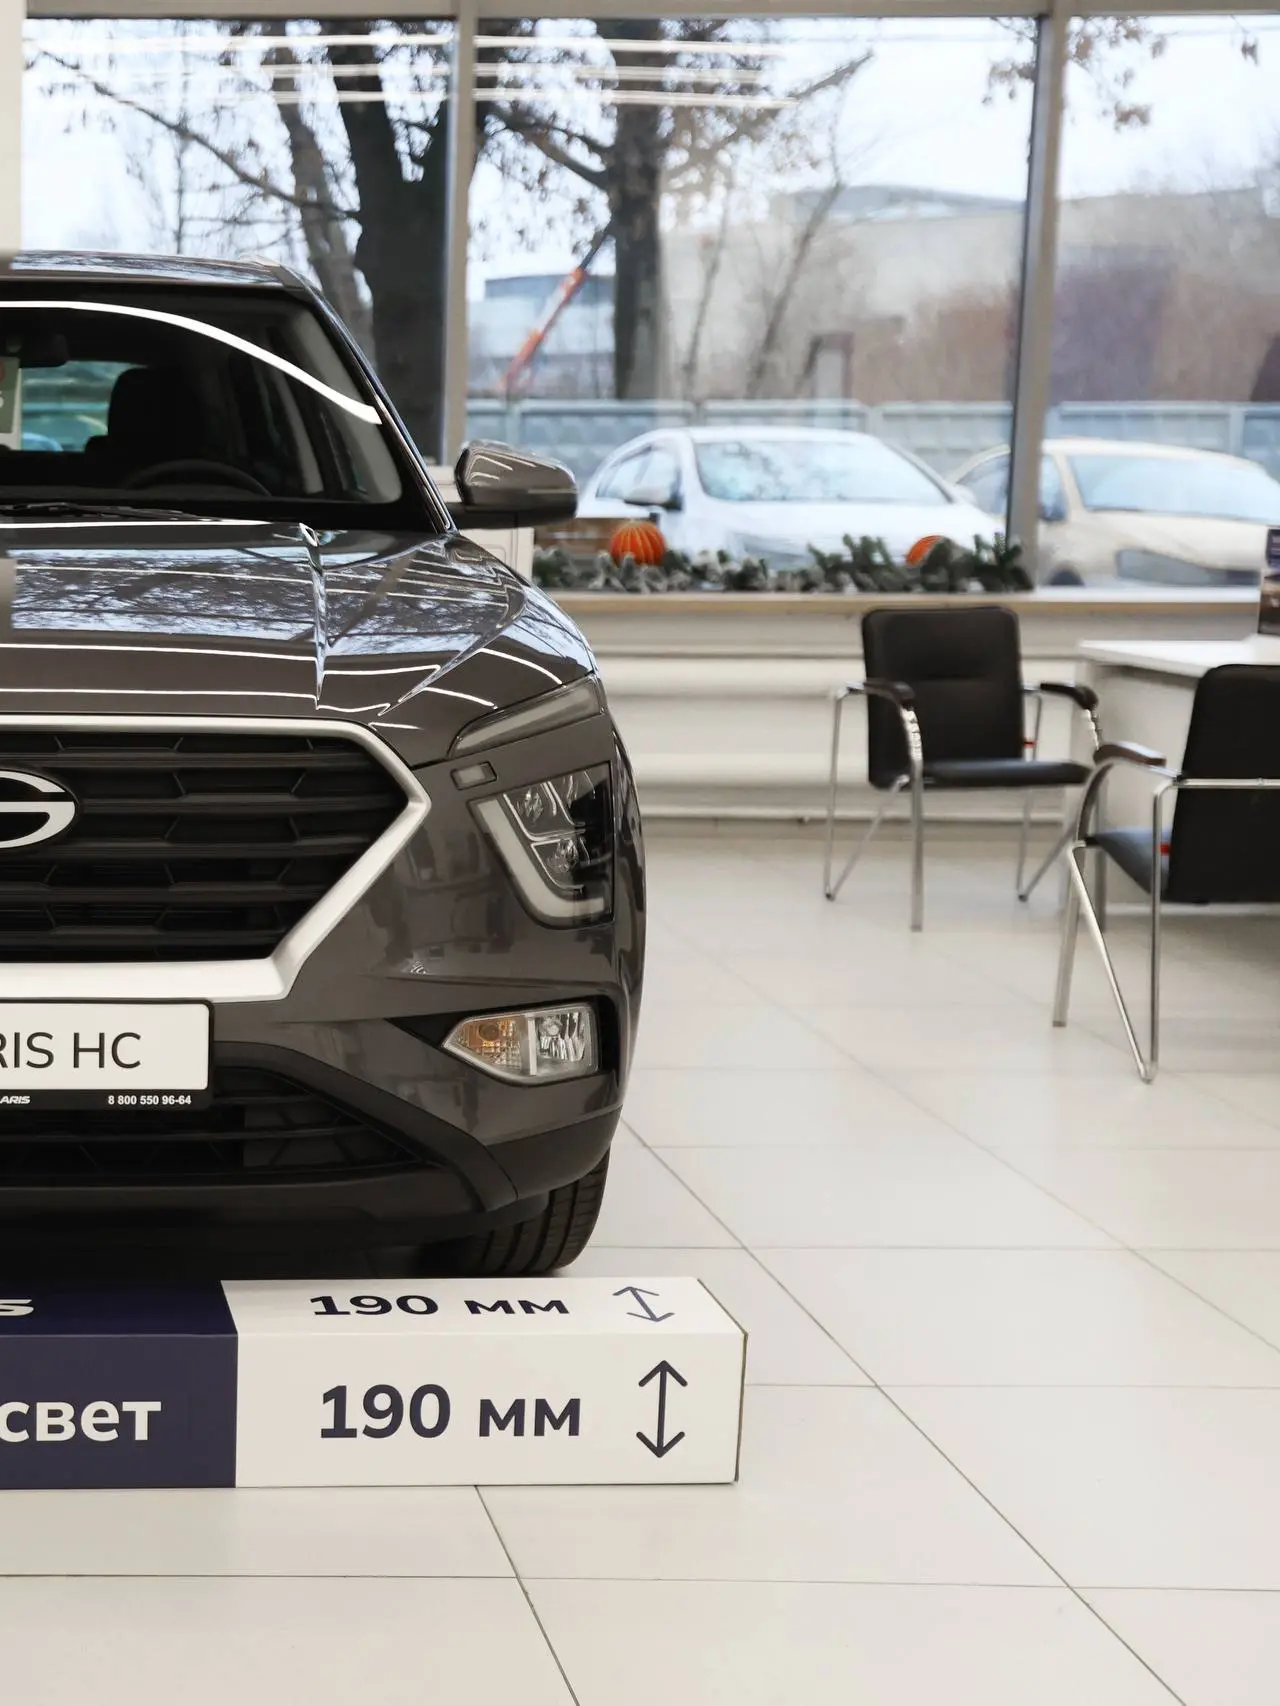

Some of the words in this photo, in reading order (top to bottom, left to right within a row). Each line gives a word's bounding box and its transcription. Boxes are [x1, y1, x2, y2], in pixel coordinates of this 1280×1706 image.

[72, 1031, 143, 1069] HC
[107, 1094, 115, 1106] 8
[117, 1094, 138, 1106] 800
[139, 1094, 160, 1106] 550
[161, 1094, 192, 1106] 96-64
[309, 1294, 439, 1317] 190
[463, 1299, 571, 1315] мм
[320, 1383, 452, 1439] 190
[478, 1397, 582, 1438] мм
